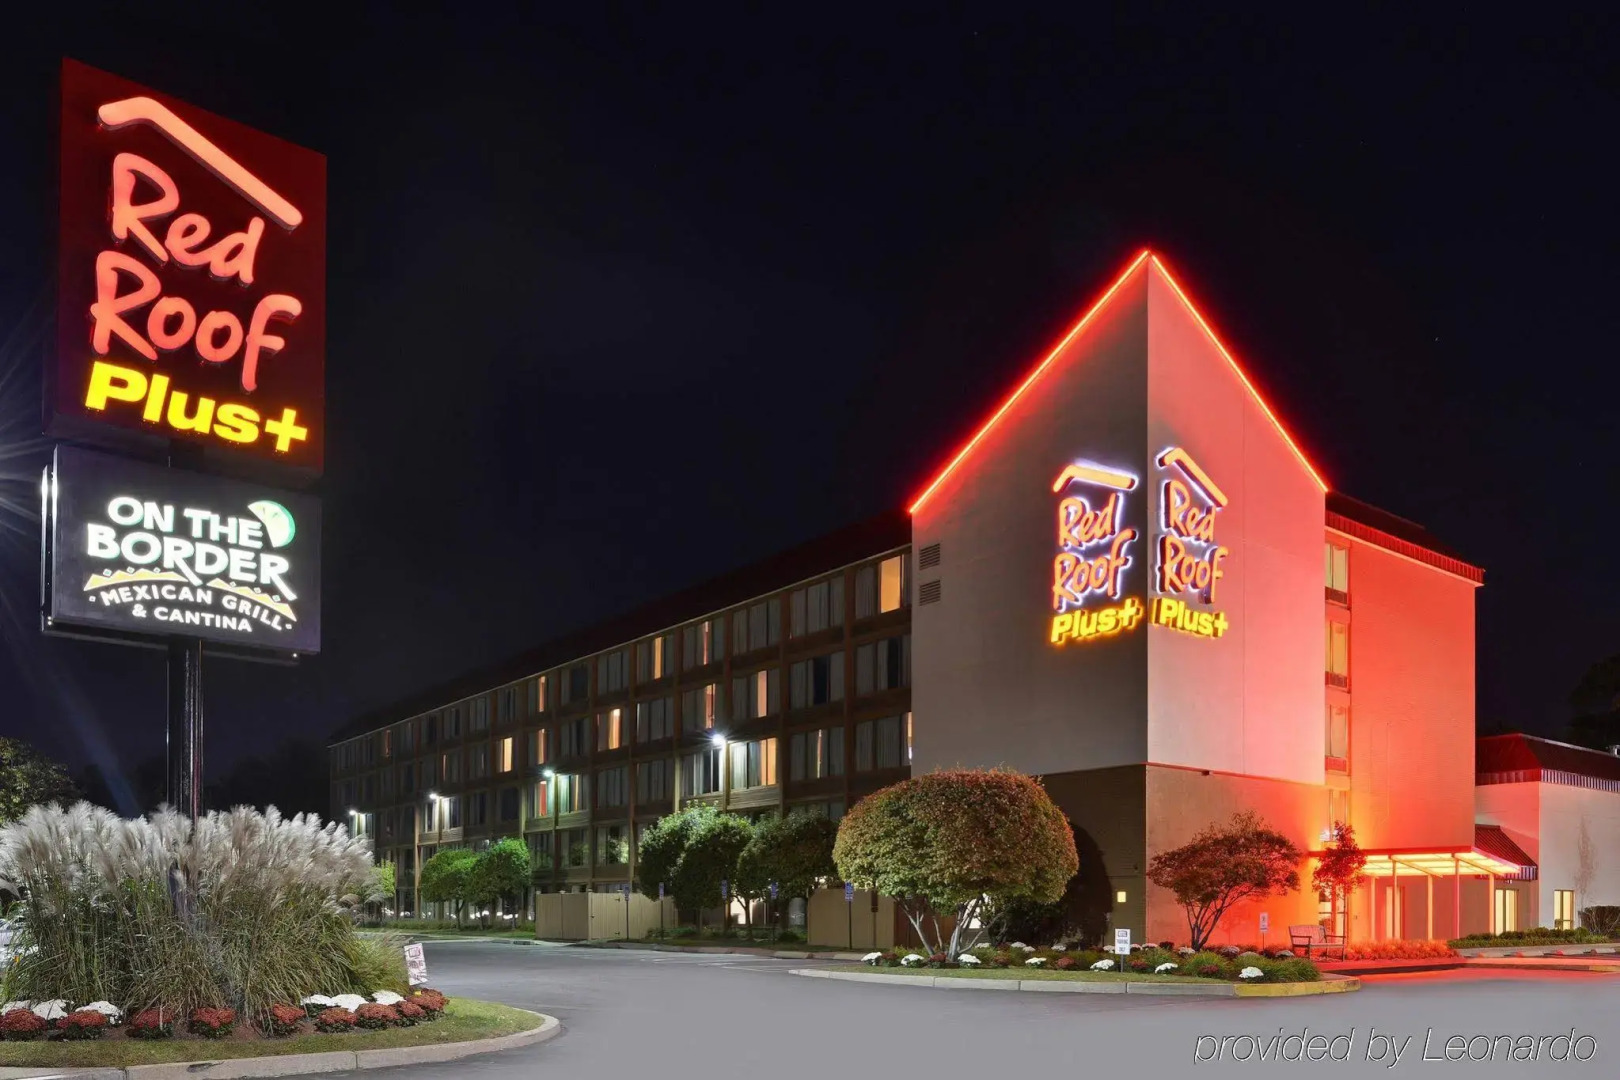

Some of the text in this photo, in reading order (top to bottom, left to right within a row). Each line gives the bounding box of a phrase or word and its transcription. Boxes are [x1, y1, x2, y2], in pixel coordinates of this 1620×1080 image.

[112, 152, 265, 284] Red
[90, 250, 302, 391] Roof
[84, 360, 308, 452] Plus+
[107, 496, 263, 549] ON THE
[1058, 492, 1124, 549] Red
[1162, 479, 1217, 545] Red
[87, 522, 298, 601] BORDER
[1053, 528, 1138, 612] Roof
[1157, 533, 1229, 605] Roof
[100, 583, 283, 632] MEXICAN GRILL
[132, 603, 252, 633] & CANTINA
[1050, 597, 1144, 644] Plus+
[1152, 597, 1229, 639] Plus+
